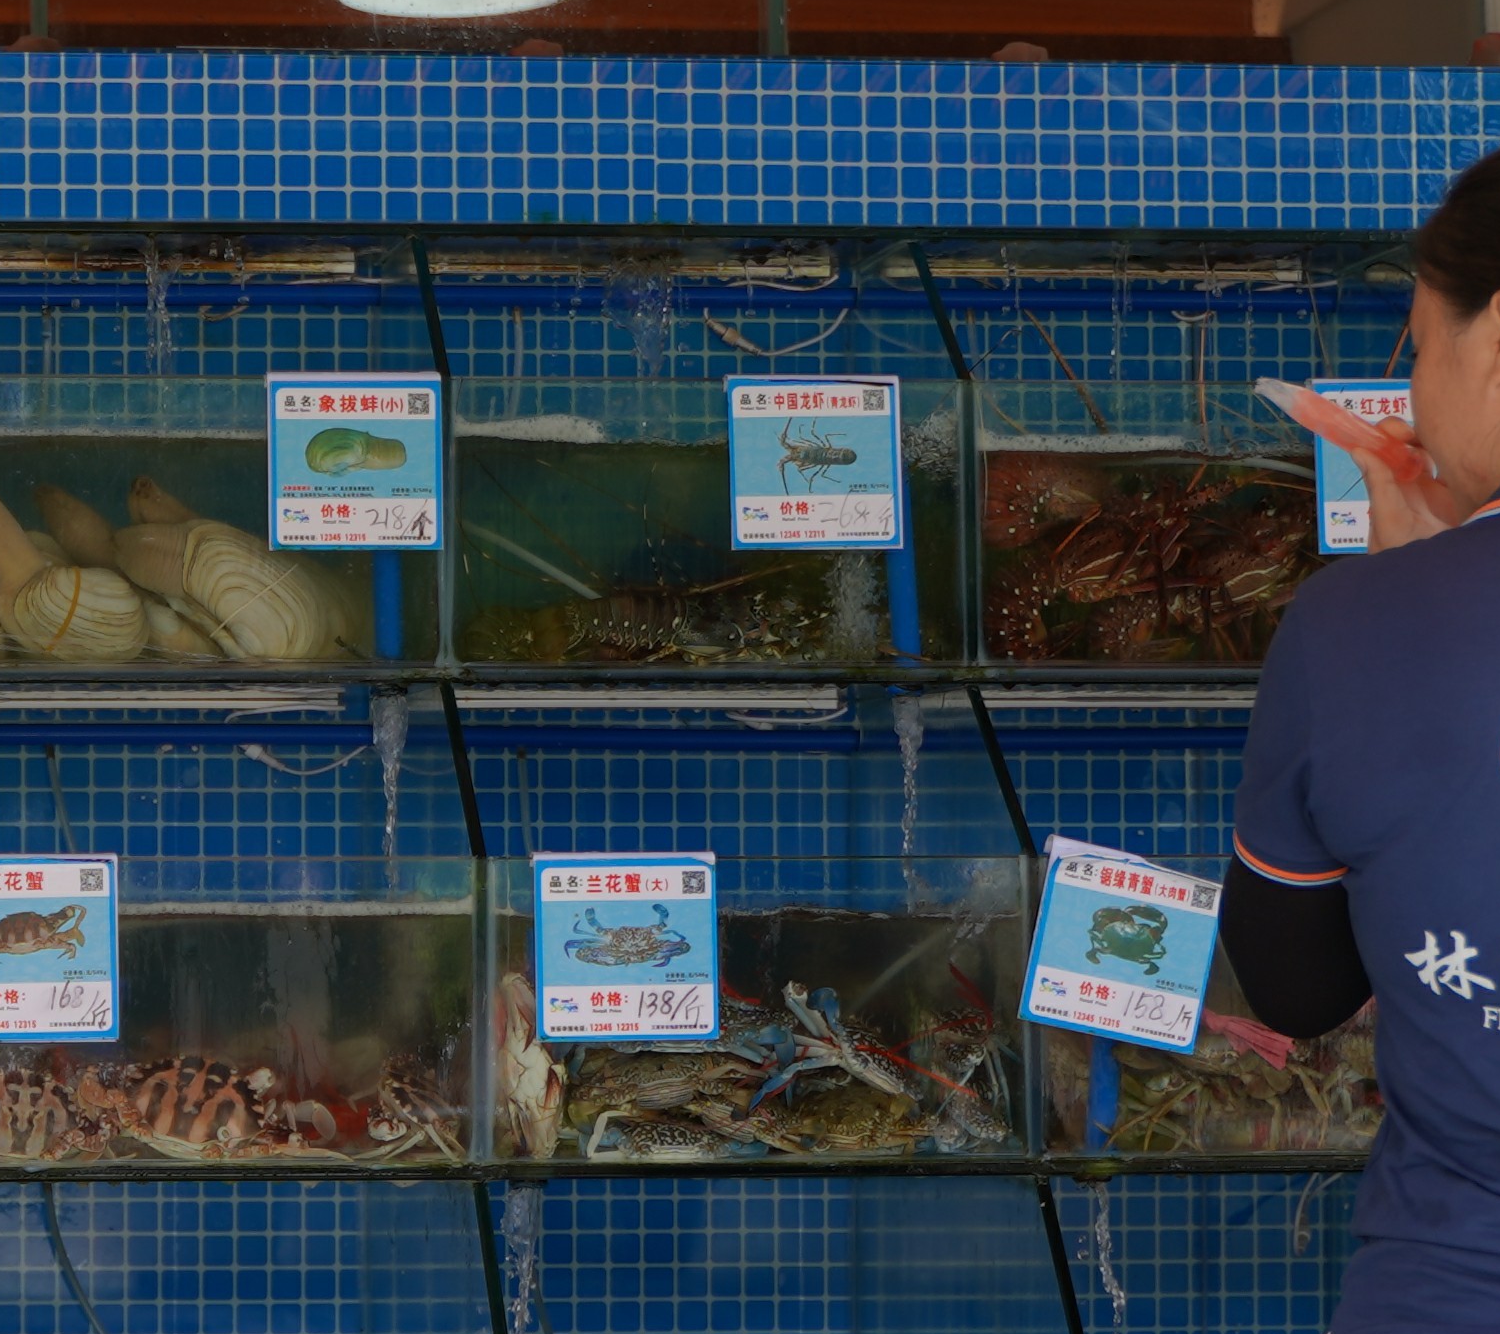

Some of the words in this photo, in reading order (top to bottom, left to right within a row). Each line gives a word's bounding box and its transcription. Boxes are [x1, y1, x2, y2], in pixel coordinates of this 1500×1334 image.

[320, 504, 357, 518] 价格:
[780, 501, 814, 516] 价格:
[1079, 980, 1116, 1000] 价格:
[590, 991, 628, 1007] 价格:
